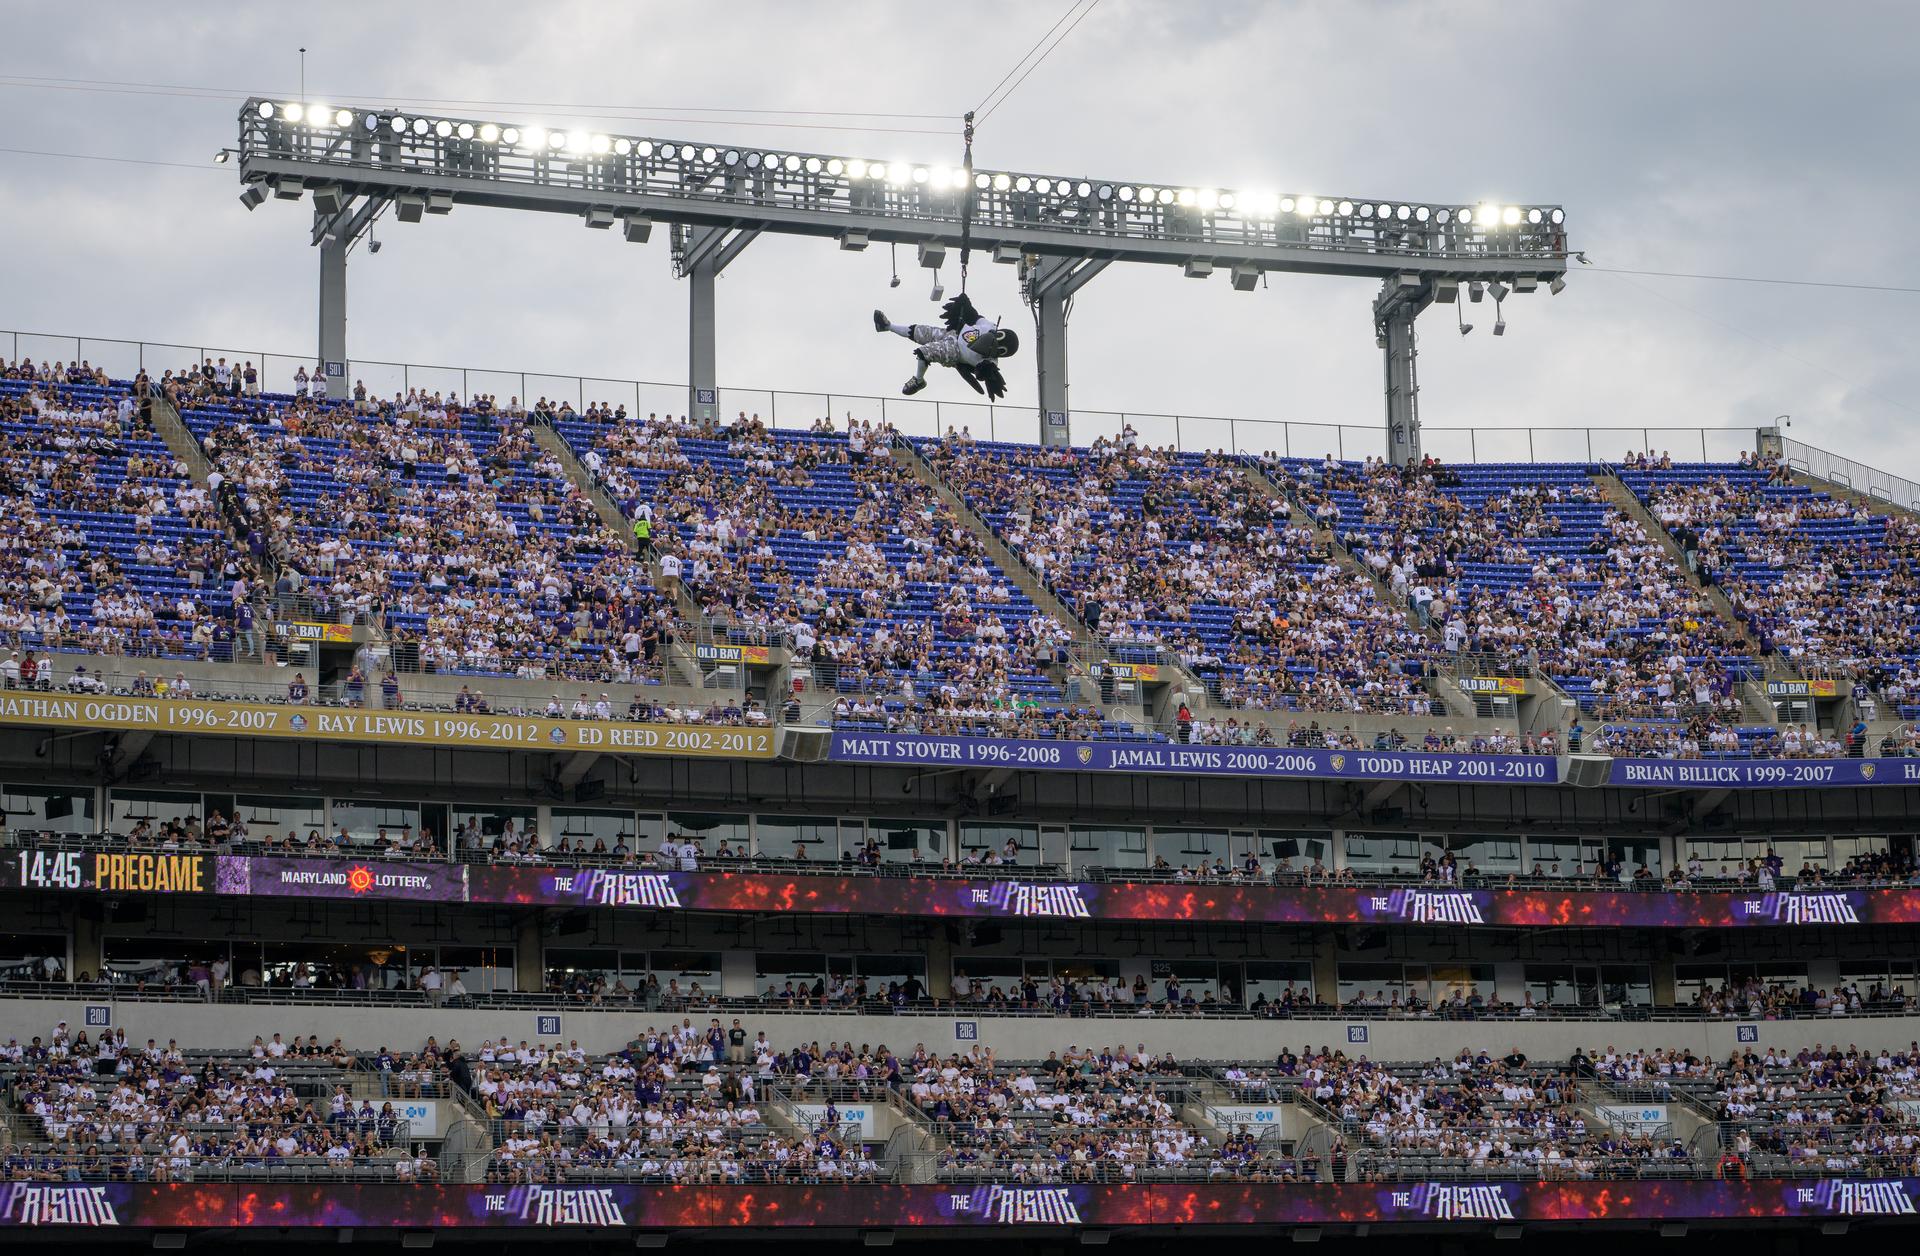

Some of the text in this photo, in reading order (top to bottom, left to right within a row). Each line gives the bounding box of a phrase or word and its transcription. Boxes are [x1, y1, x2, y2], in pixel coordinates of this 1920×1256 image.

[300, 626, 320, 638] BAY
[697, 647, 740, 660] OLD BAY
[1112, 666, 1130, 677] BAY
[1460, 680, 1496, 690] OLD BAY
[1768, 683, 1807, 694] OLD BAY
[84, 702, 158, 724] OGDEN
[168, 707, 278, 729] 1996-2007
[318, 714, 538, 742] RAY LEWIS 1996-2012
[578, 728, 768, 751] ED REED 2002-2012
[842, 739, 1061, 763] MATT STOVER 1996-2008
[1109, 750, 1316, 772] JAMAL LEWIS 2000-2006
[1358, 758, 1545, 778] TODD HEAP 2001-2010
[1625, 766, 1834, 782] BRIAN BILLICK 1999-2007
[18, 850, 204, 892] 14:45 PREGAME
[282, 871, 346, 885] MARYLAND
[555, 877, 572, 891] THE
[972, 889, 988, 902] THE
[1371, 897, 1387, 910] THE
[1744, 901, 1760, 914] THE
[1153, 963, 1171, 973] 325
[90, 1008, 106, 1024] 200
[542, 1018, 556, 1032] 201
[960, 1024, 973, 1038] 202
[1351, 1028, 1365, 1041] 203
[1740, 1028, 1754, 1040] 204
[485, 1194, 506, 1210] THE
[951, 1194, 970, 1210] THE
[1392, 1192, 1410, 1207] THE
[1796, 1188, 1814, 1202] THE
[0, 1182, 120, 1226] PRISING
